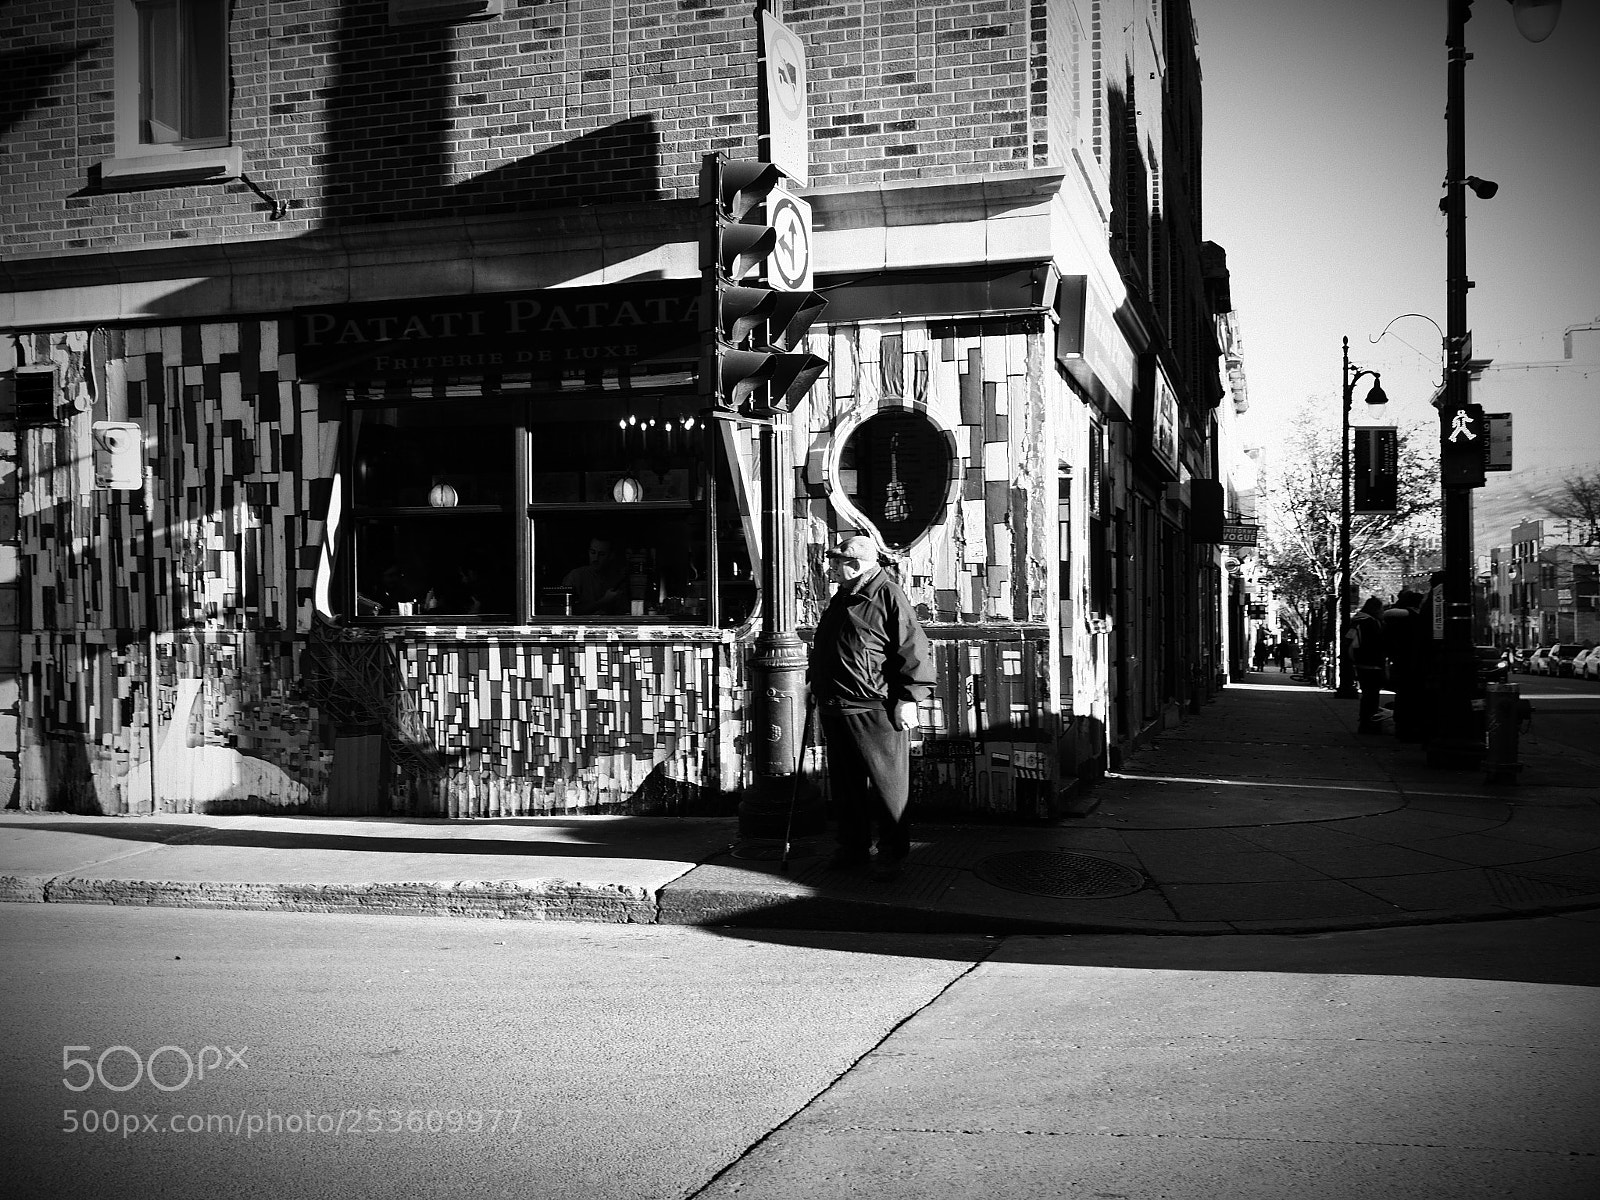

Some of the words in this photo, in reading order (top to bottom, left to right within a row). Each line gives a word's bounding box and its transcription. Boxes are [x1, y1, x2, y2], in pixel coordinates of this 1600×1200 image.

[302, 310, 486, 347] PATATI
[374, 352, 504, 371] FRITERIE
[515, 348, 552, 364] DE
[564, 344, 640, 361] LUXE
[1223, 533, 1256, 541] VOGUE
